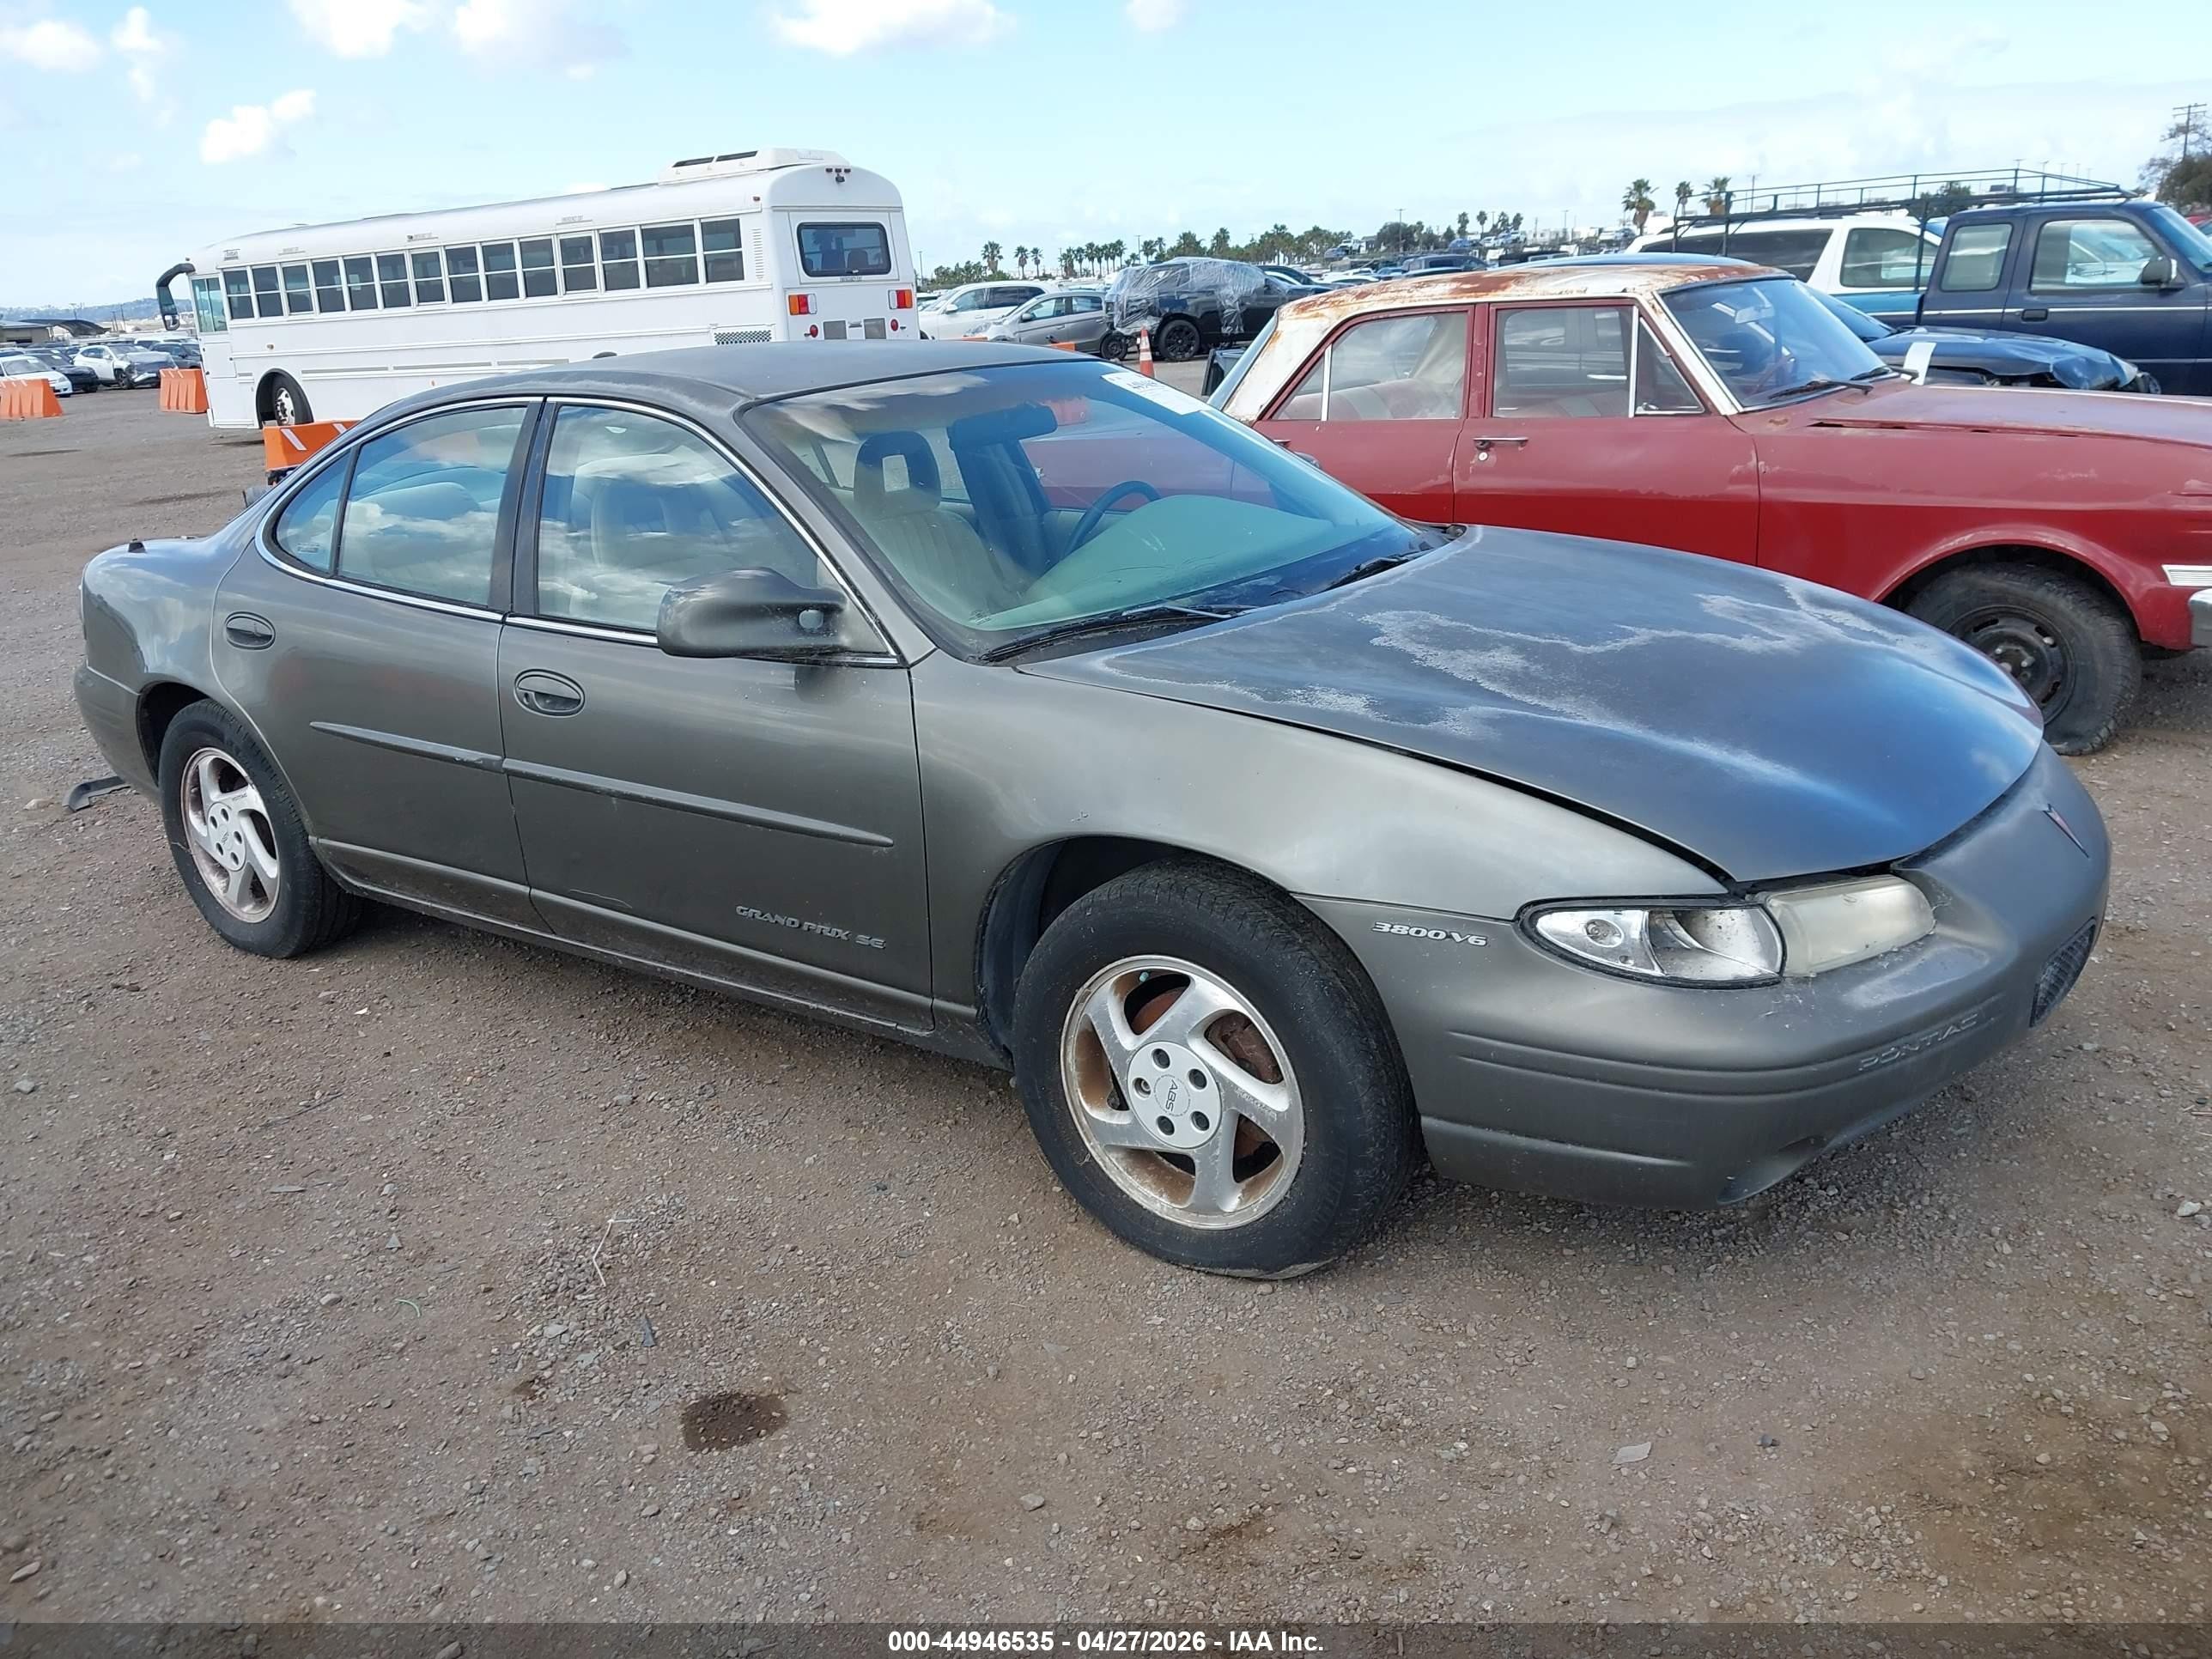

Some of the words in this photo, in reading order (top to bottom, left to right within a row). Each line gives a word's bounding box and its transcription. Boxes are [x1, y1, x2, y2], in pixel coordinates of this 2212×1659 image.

[735, 905, 799, 928] GRAND
[803, 921, 853, 941] PRIX
[1165, 1079, 1178, 1112] ABS
